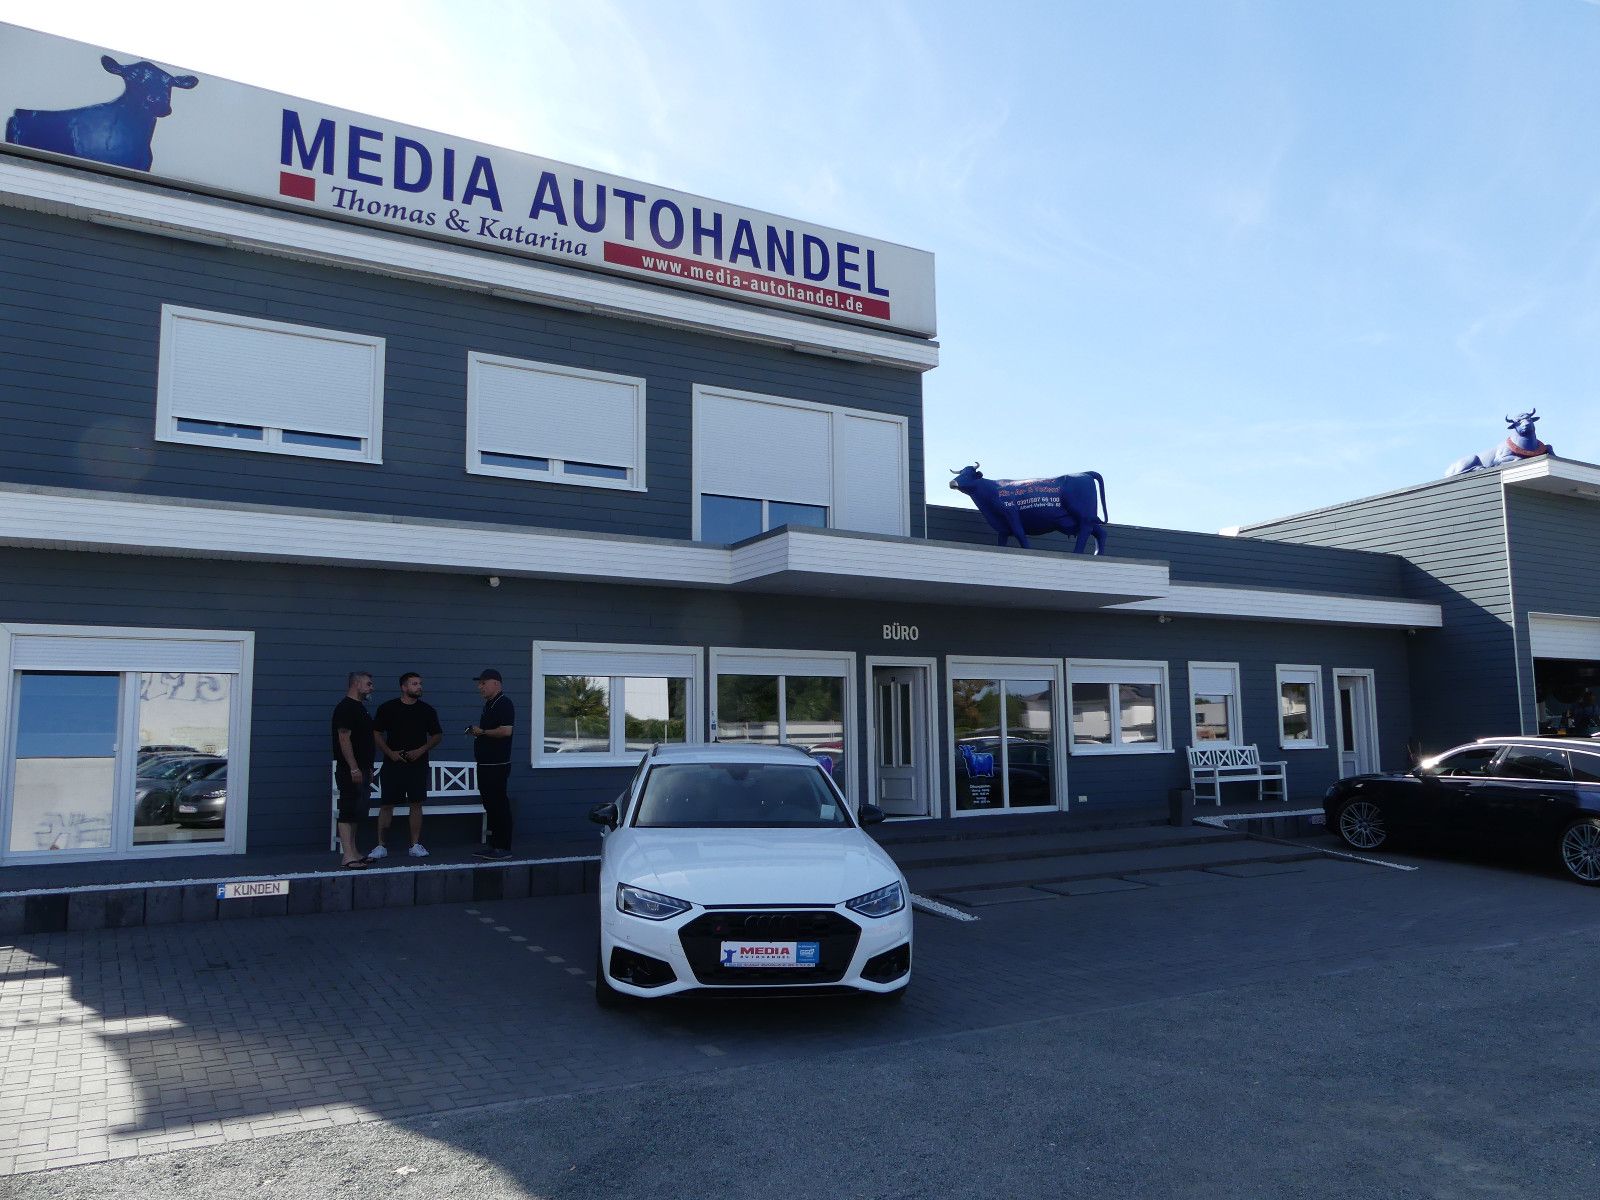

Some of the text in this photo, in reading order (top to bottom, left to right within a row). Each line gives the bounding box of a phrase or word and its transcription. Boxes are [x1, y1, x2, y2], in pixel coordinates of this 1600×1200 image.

[280, 108, 890, 298] MEDIA AUTOHANDEL
[331, 185, 588, 257] Thomas & Katarina
[641, 253, 864, 314] www.media-autohandel.de
[882, 622, 919, 641] BÜRO
[233, 882, 281, 897] KUNDEN
[740, 946, 790, 955] MEDIA
